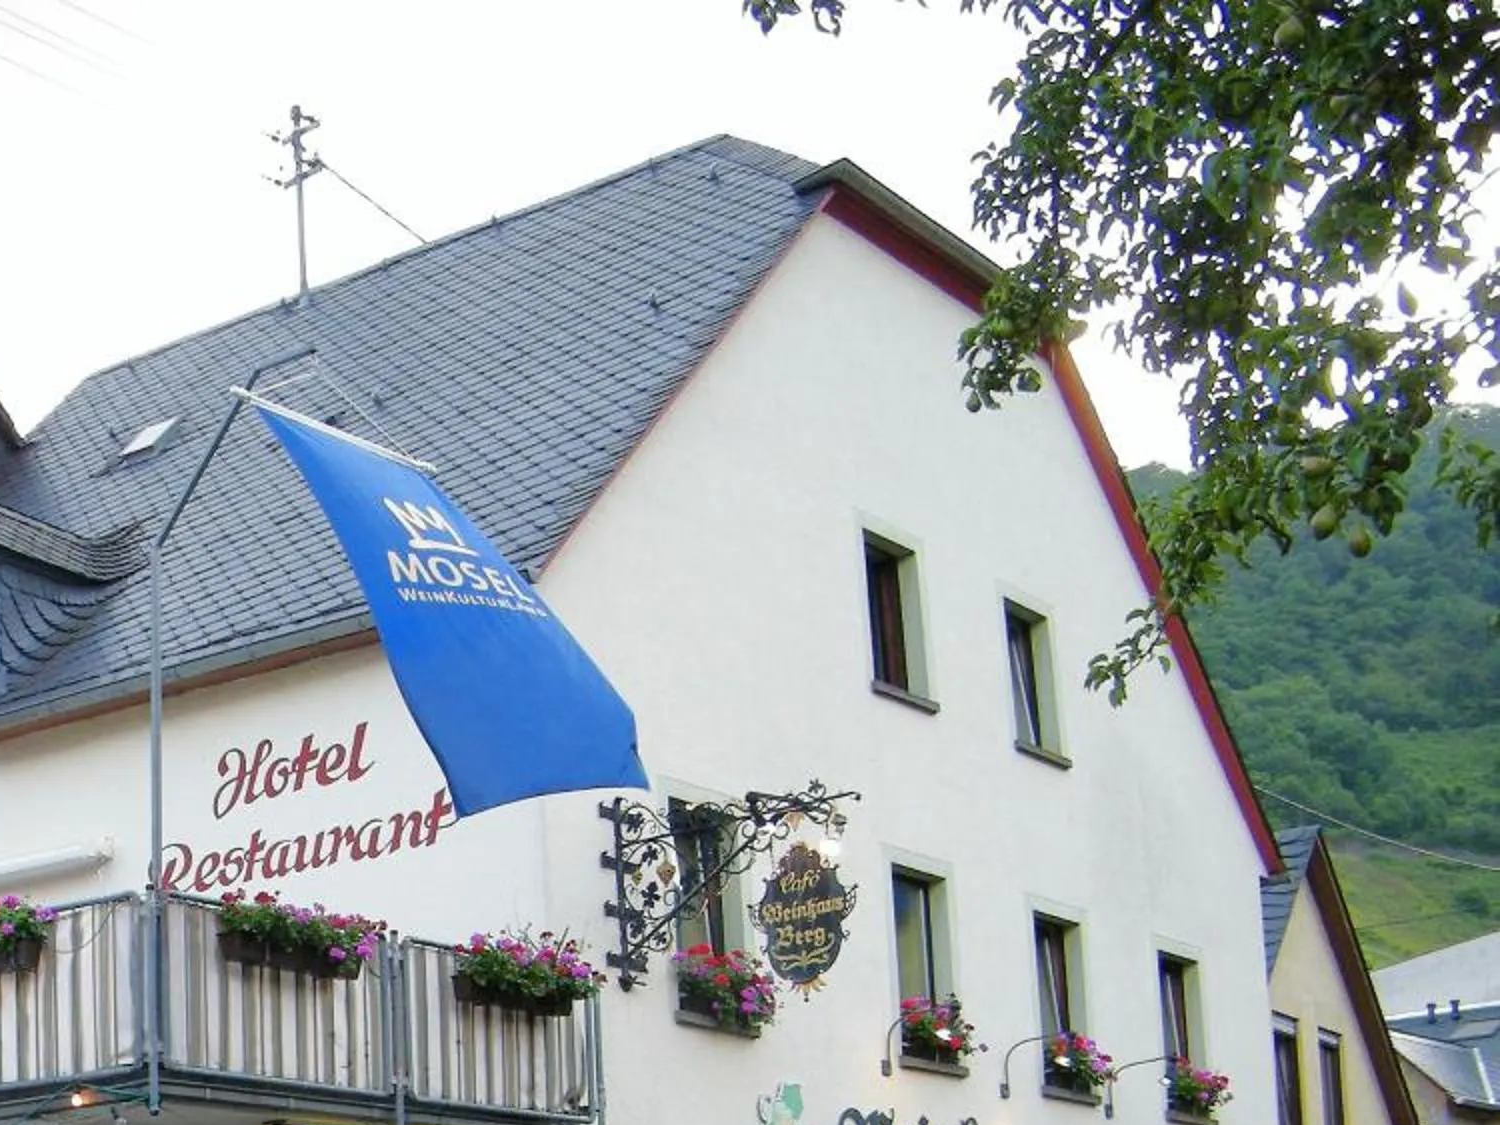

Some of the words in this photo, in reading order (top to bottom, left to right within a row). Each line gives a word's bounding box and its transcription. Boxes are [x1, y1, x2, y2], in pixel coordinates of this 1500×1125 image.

[387, 550, 534, 605] MOSEL
[214, 721, 376, 819] Hotel
[148, 787, 461, 892] Restaurant
[761, 896, 845, 924] Weinhaus
[776, 926, 826, 946] Berg
